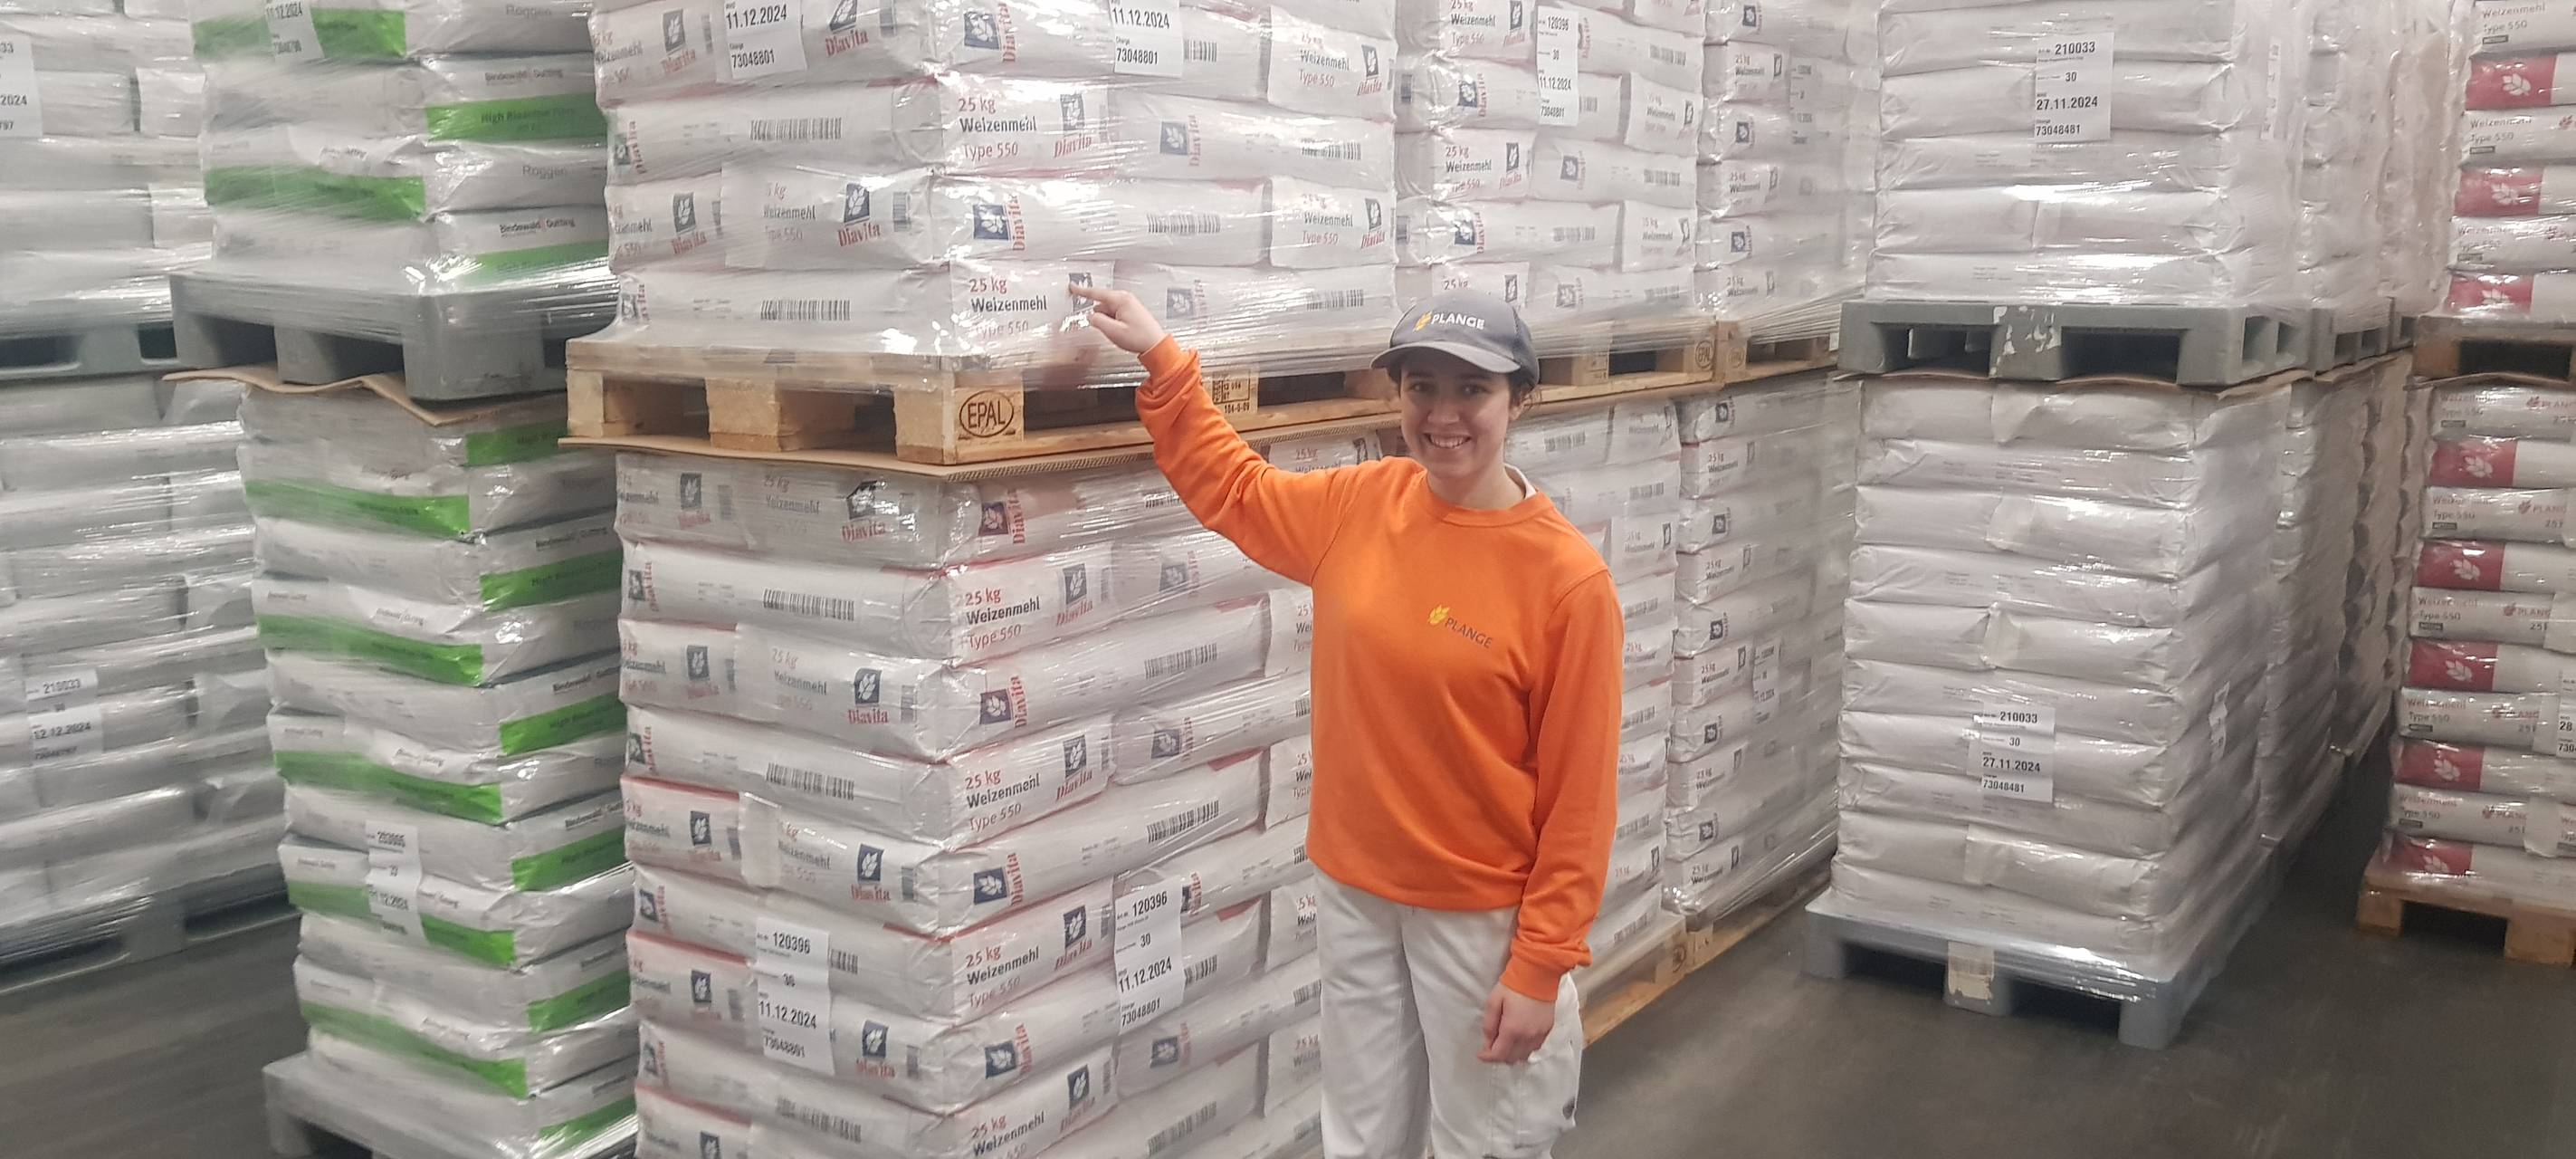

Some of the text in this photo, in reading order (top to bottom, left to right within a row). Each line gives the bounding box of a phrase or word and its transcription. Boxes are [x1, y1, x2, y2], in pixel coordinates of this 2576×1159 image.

[505, 5, 552, 17] Roggen
[726, 4, 787, 30] 11.12.2024
[1112, 7, 1169, 30] 11.12.2024
[1450, 14, 1495, 27] Weizenmehl
[2482, 5, 2546, 18] Weizenmehl
[2508, 21, 2528, 31] 550
[825, 29, 870, 57] Diavita
[2055, 42, 2096, 55] 210033
[731, 49, 776, 69] 73048801
[1116, 46, 1159, 65] 73048801
[1300, 49, 1350, 71] Weizenmehl
[1299, 70, 1334, 87] Type 550
[1540, 77, 1571, 91] 11.12.2024
[2065, 72, 2077, 82] 30
[958, 96, 997, 114] 25 kg
[2037, 96, 2098, 110] 27.11.2024
[959, 115, 1037, 133] Weizenmehl
[2036, 124, 2081, 137] 73048481
[962, 142, 1019, 160] Type 550
[1054, 135, 1092, 158] Diavita
[1445, 146, 1470, 159] 25 kg
[522, 165, 568, 179] Roggen
[1445, 159, 1493, 174] Weizenmehl
[1303, 211, 1353, 227] Weizenmehl
[837, 224, 881, 247] Diavita
[968, 275, 1007, 294] 25 kg
[970, 295, 1047, 314] Weizenmehl
[1007, 321, 1029, 333] 550
[1430, 312, 1485, 330] PLANGE
[968, 400, 1006, 428] EPAL
[965, 587, 1001, 606] 25 kg
[966, 596, 1041, 626] Weizenmehl
[1056, 599, 1093, 627] Diavita
[1297, 605, 1310, 617] 25
[968, 633, 997, 651] Type
[1445, 618, 1493, 648] PLANGE
[772, 647, 798, 668] 25 kg
[774, 669, 827, 695] Weizenmehl
[1011, 675, 1028, 728] Diavita
[848, 708, 889, 724] Diavita
[1999, 711, 2038, 723] 210033
[2009, 737, 2020, 747] 30
[1982, 756, 2041, 772] 27.11.2024
[965, 770, 1001, 790] 25 kg
[1055, 771, 1093, 802] Diavita
[1983, 779, 2025, 793] 73048481
[966, 772, 1041, 809] Weizenmehl
[969, 803, 1022, 832] Type 550
[1007, 852, 1024, 905] Diavita
[1131, 891, 1168, 916] 120396
[773, 932, 810, 954] 120396
[1140, 933, 1151, 947] 30
[966, 945, 1001, 968] 25 kg
[967, 949, 1040, 986] Weizenmehl
[1119, 956, 1172, 993] 11.12.2024
[999, 977, 1021, 994] 550
[759, 1001, 816, 1030] 11.12.2024
[1121, 998, 1160, 1028] 73048801
[1016, 1023, 1034, 1075] Diavita
[971, 1115, 1007, 1139] 25 kg
[972, 1111, 1045, 1157] Weizenmehl
